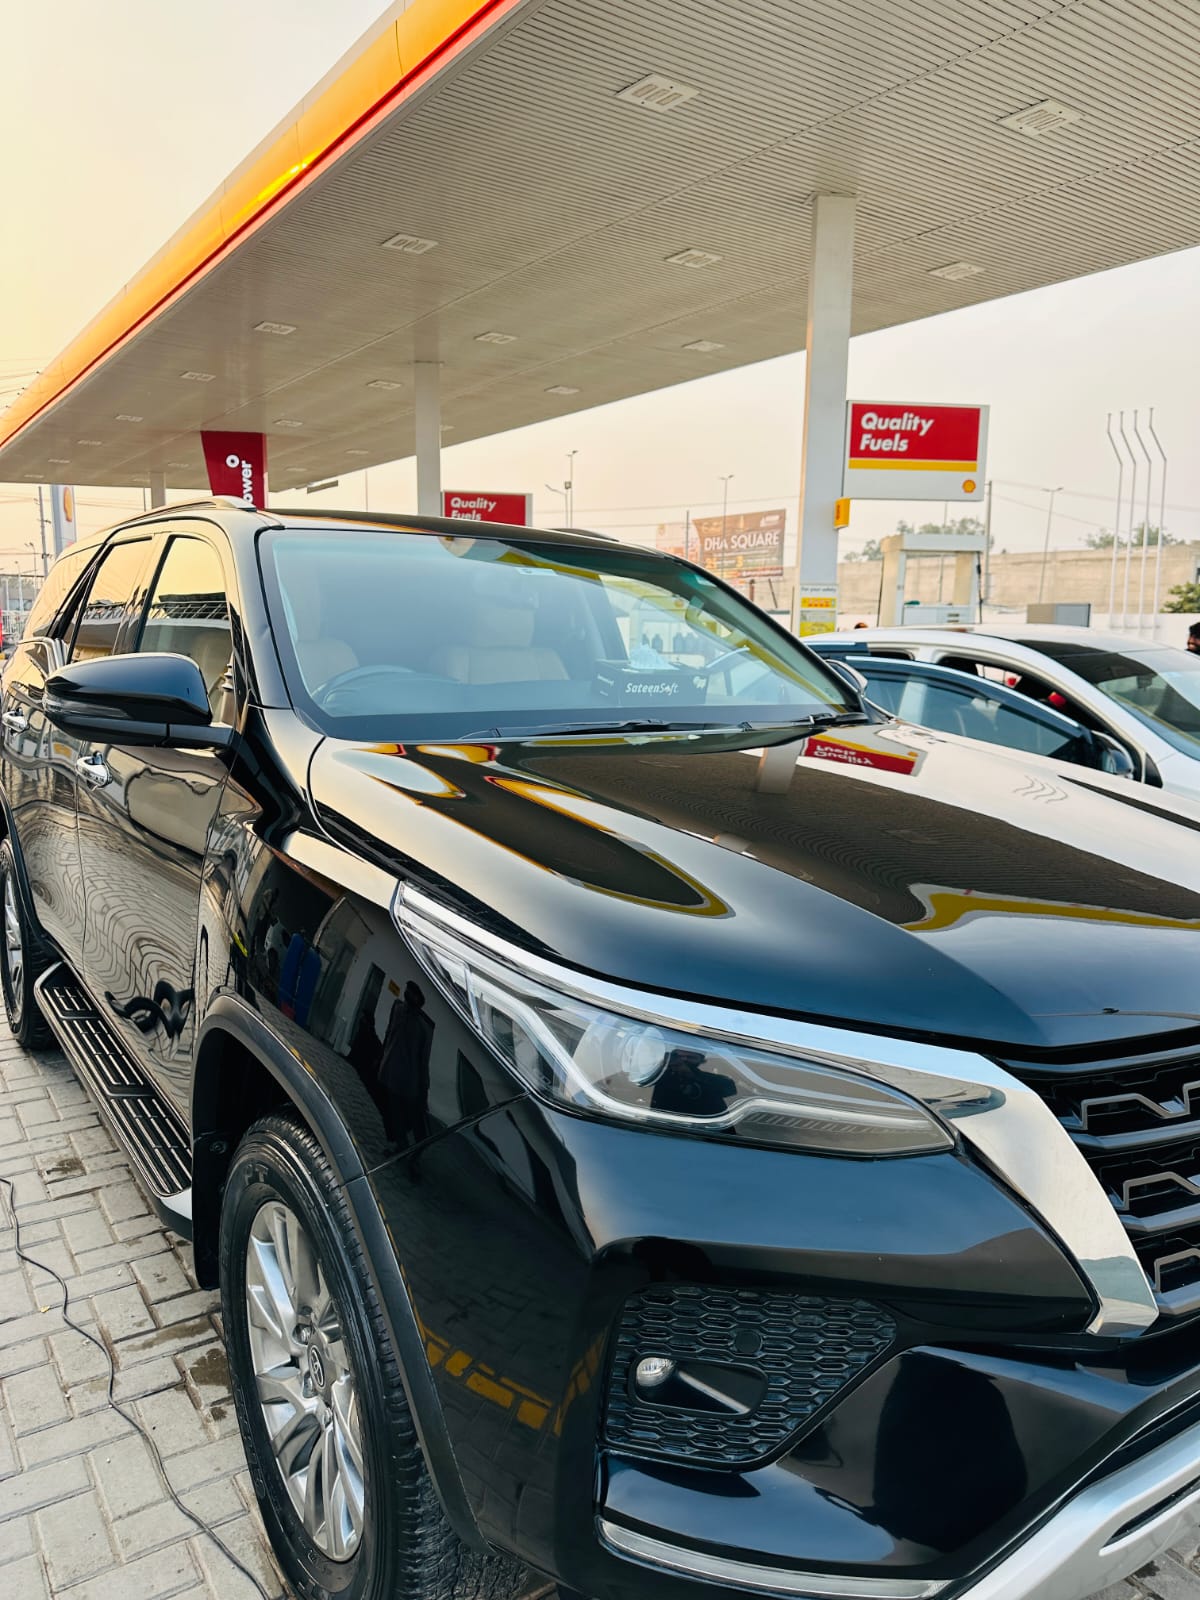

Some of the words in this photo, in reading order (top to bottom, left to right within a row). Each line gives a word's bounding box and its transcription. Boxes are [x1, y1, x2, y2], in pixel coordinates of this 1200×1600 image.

[861, 412, 934, 436] Quality
[859, 433, 909, 451] Fuels
[241, 460, 253, 504] ower
[450, 497, 496, 512] Quality
[704, 537, 729, 551] DHA
[731, 530, 779, 549] SQUARE
